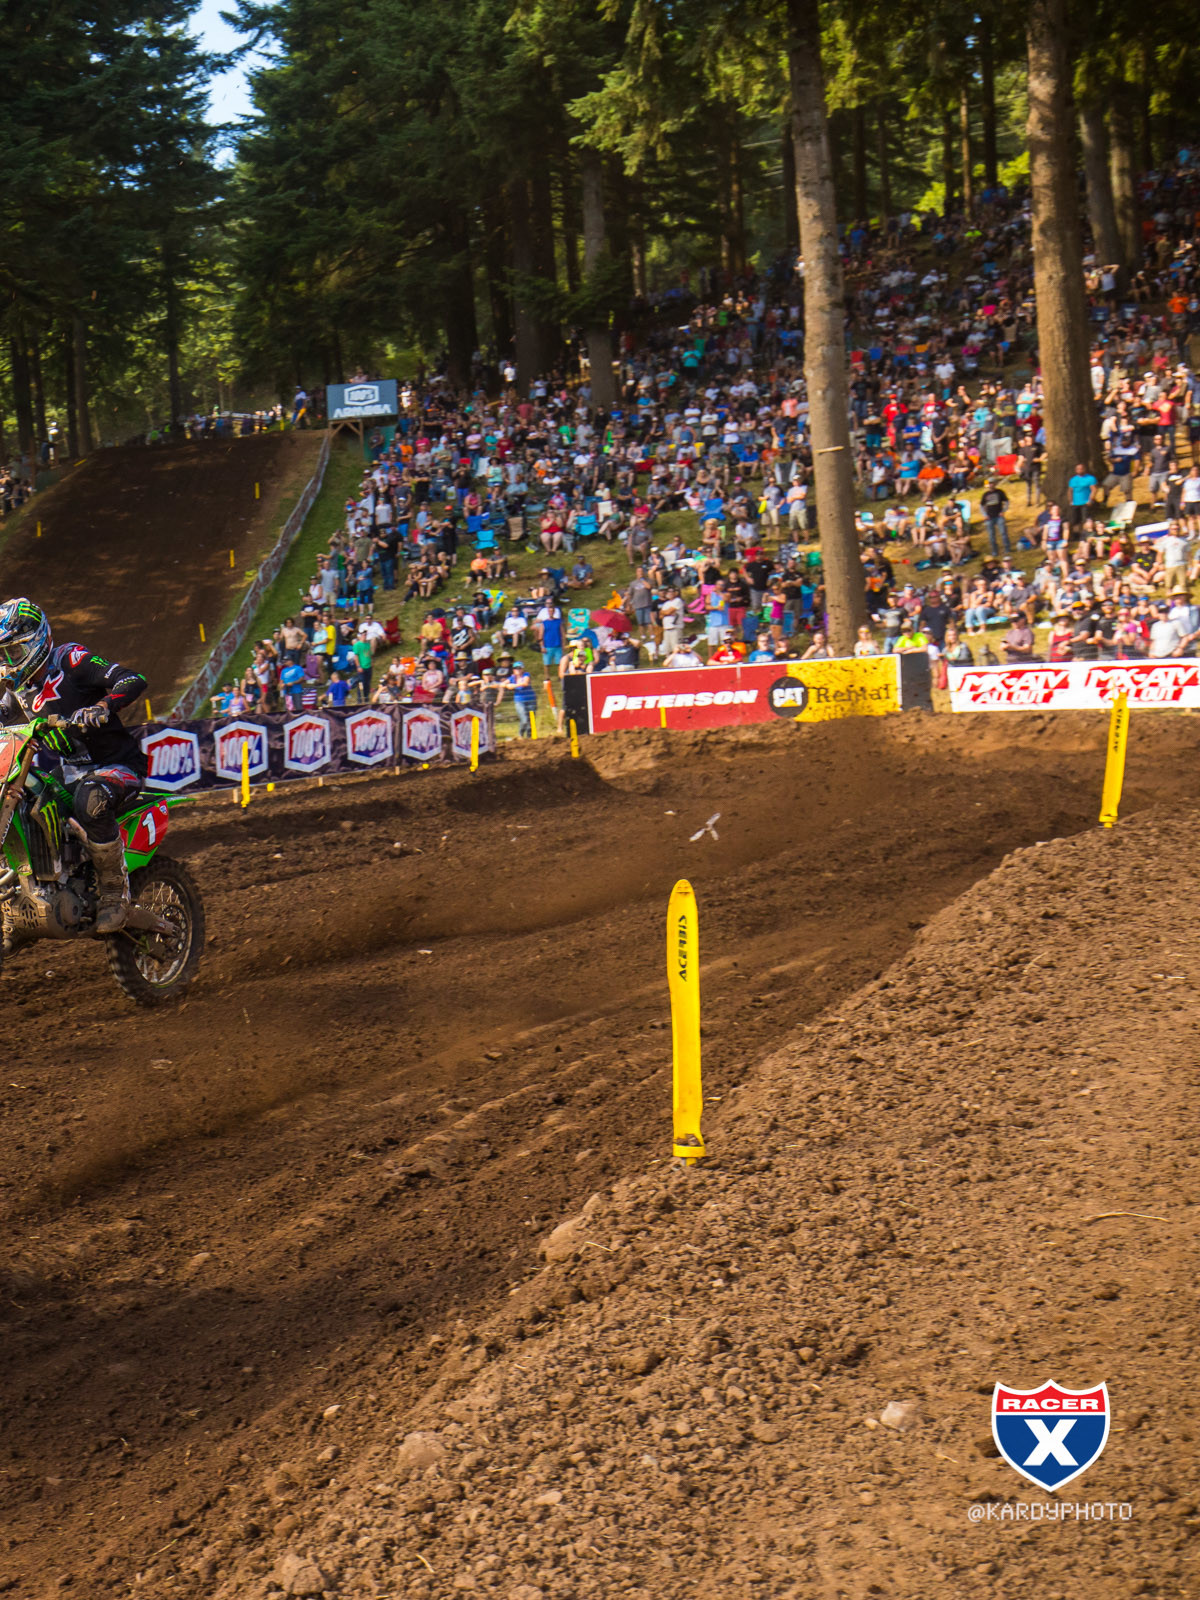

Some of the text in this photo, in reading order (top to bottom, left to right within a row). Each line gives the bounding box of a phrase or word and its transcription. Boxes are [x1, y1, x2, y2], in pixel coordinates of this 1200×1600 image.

[600, 683, 893, 719] PETERSON CAT Rental
[150, 741, 193, 776] 100%
[292, 727, 325, 759] 100%
[142, 812, 156, 846] 1
